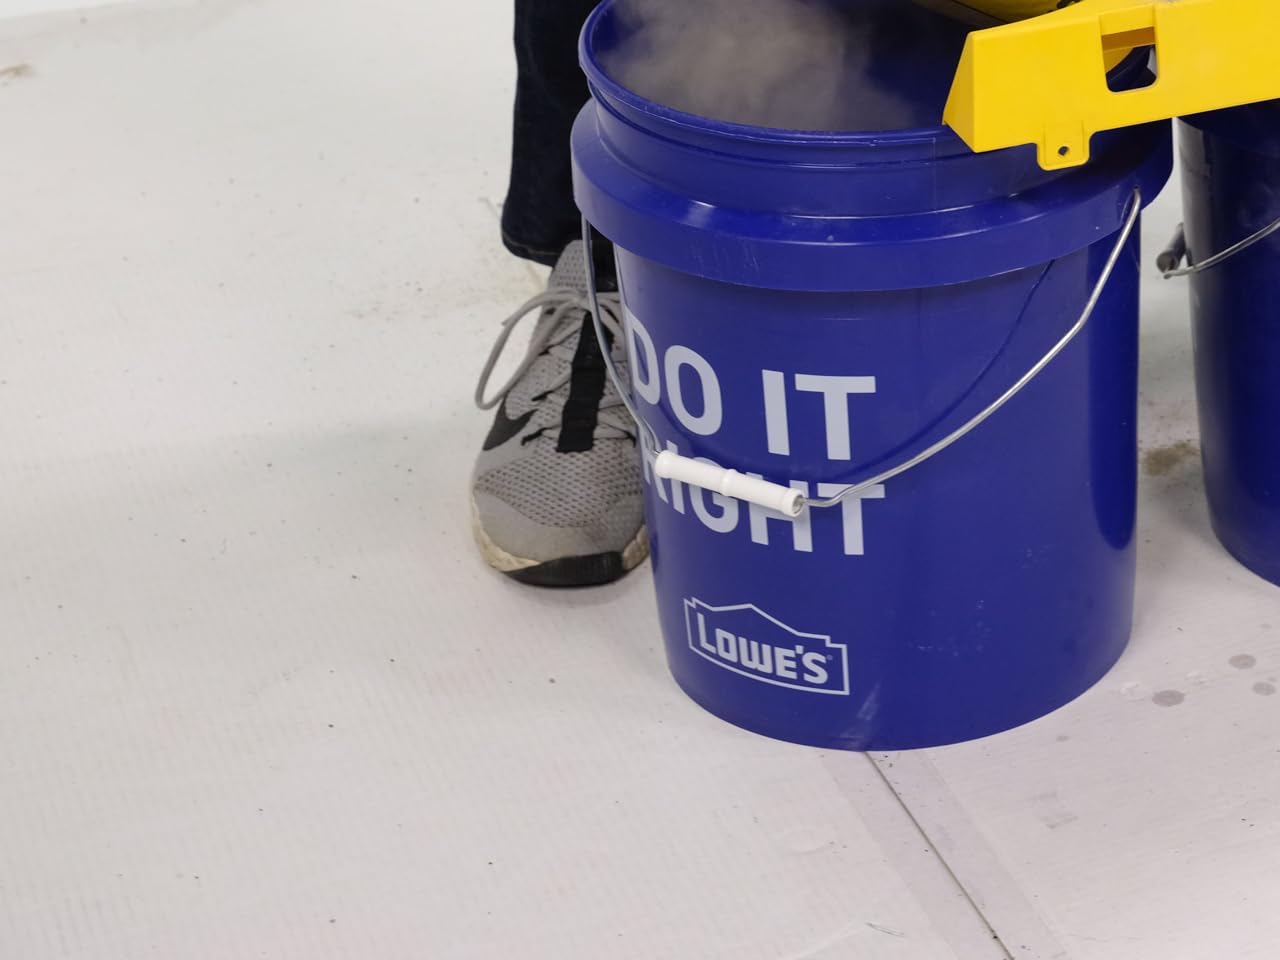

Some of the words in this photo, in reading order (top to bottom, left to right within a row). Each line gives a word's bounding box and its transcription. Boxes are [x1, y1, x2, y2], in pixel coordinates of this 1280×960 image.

[624, 302, 723, 436] DO
[762, 369, 877, 461] IT
[697, 611, 829, 685] LOWE'S
